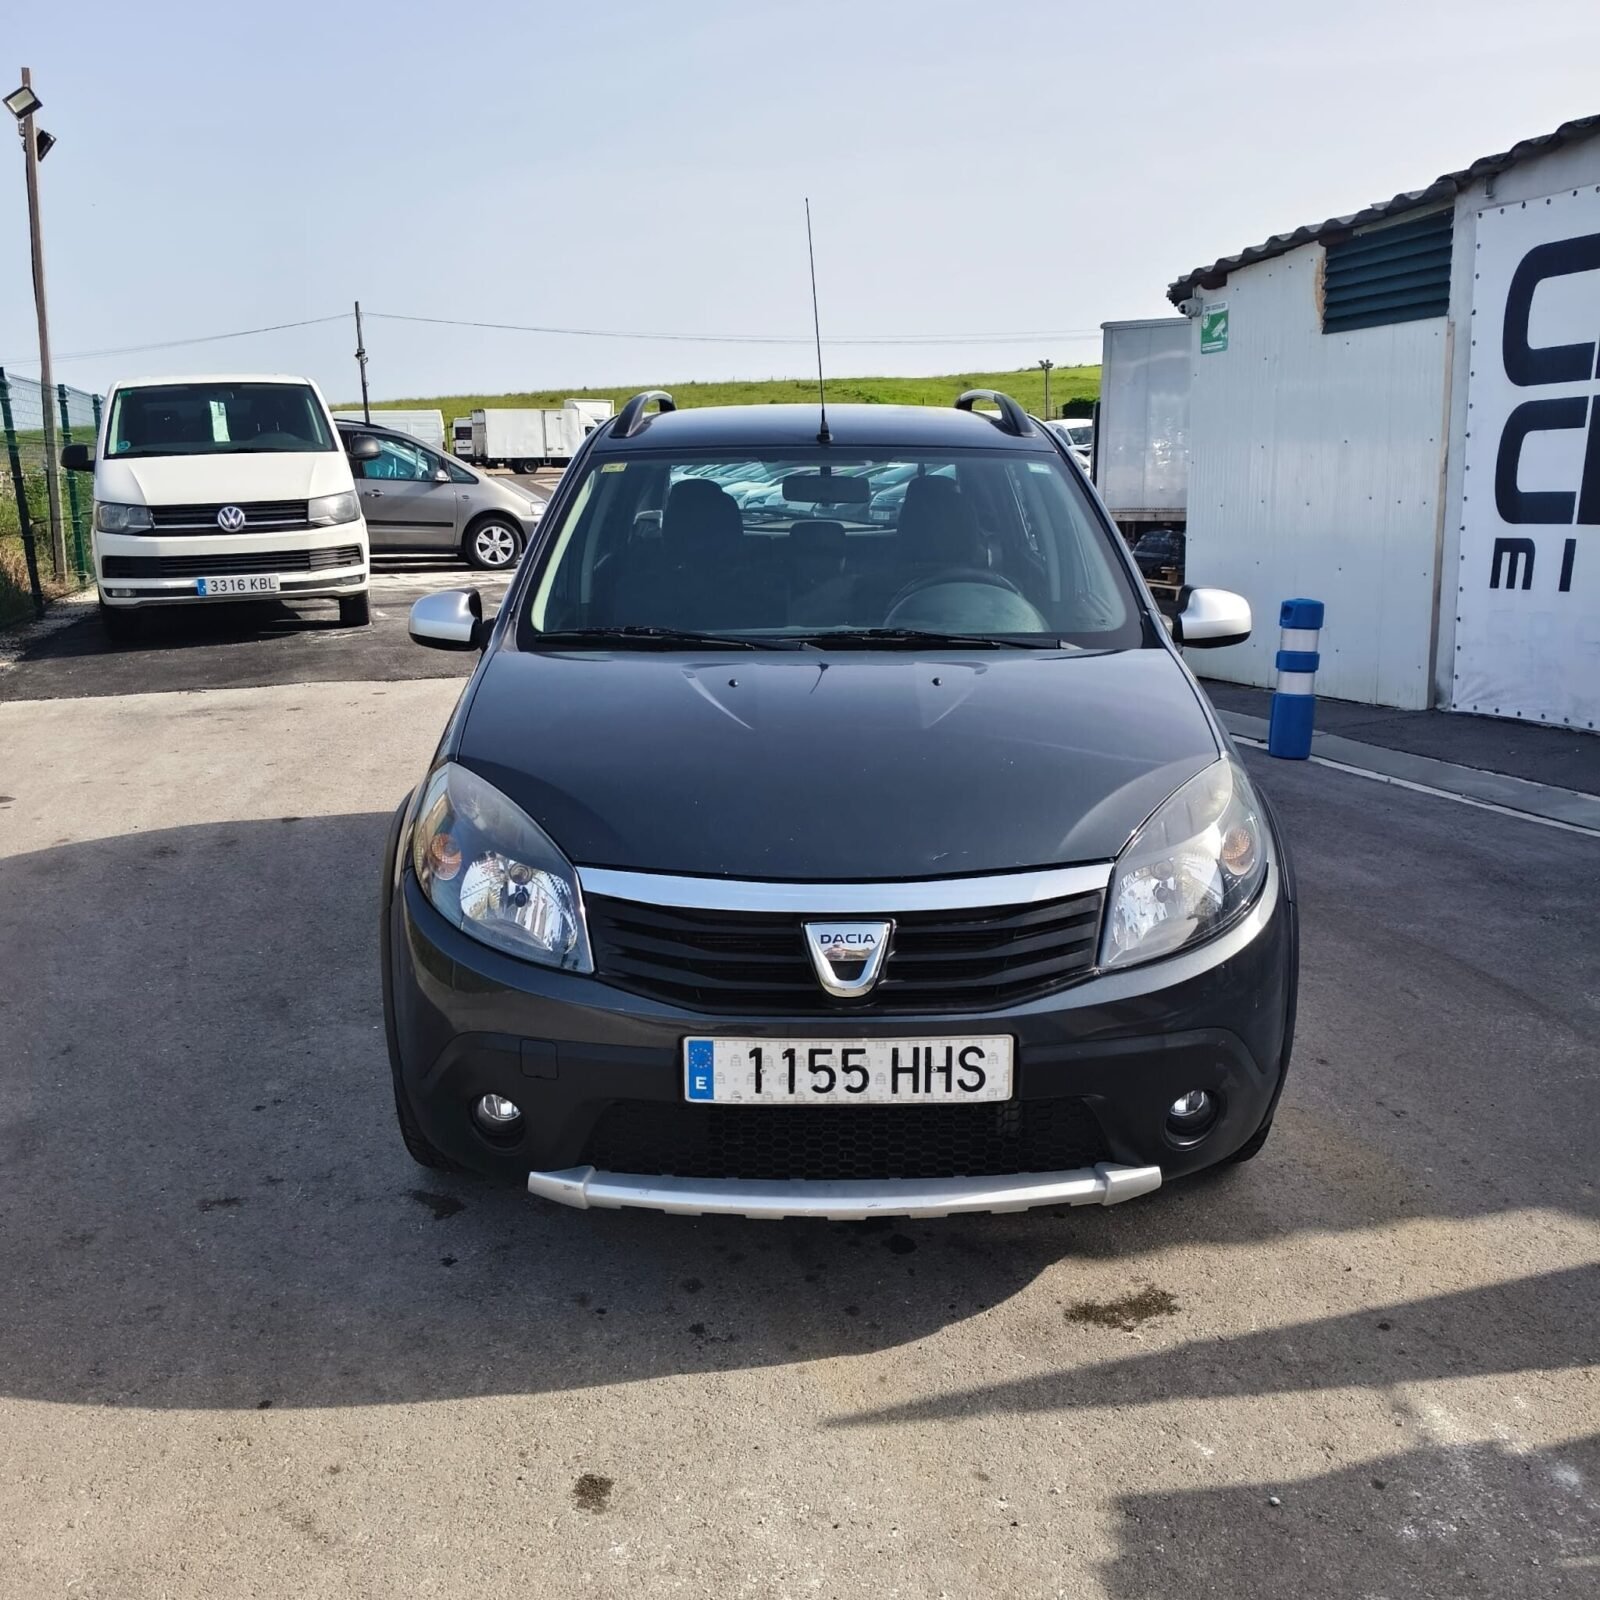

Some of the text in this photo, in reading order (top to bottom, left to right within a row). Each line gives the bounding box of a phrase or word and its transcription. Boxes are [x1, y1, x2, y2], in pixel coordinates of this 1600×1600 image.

[210, 577, 277, 592] 3316 KBL
[820, 933, 876, 944] DACIA
[749, 1045, 987, 1094] 1155 HHS
[695, 1076, 707, 1090] E
